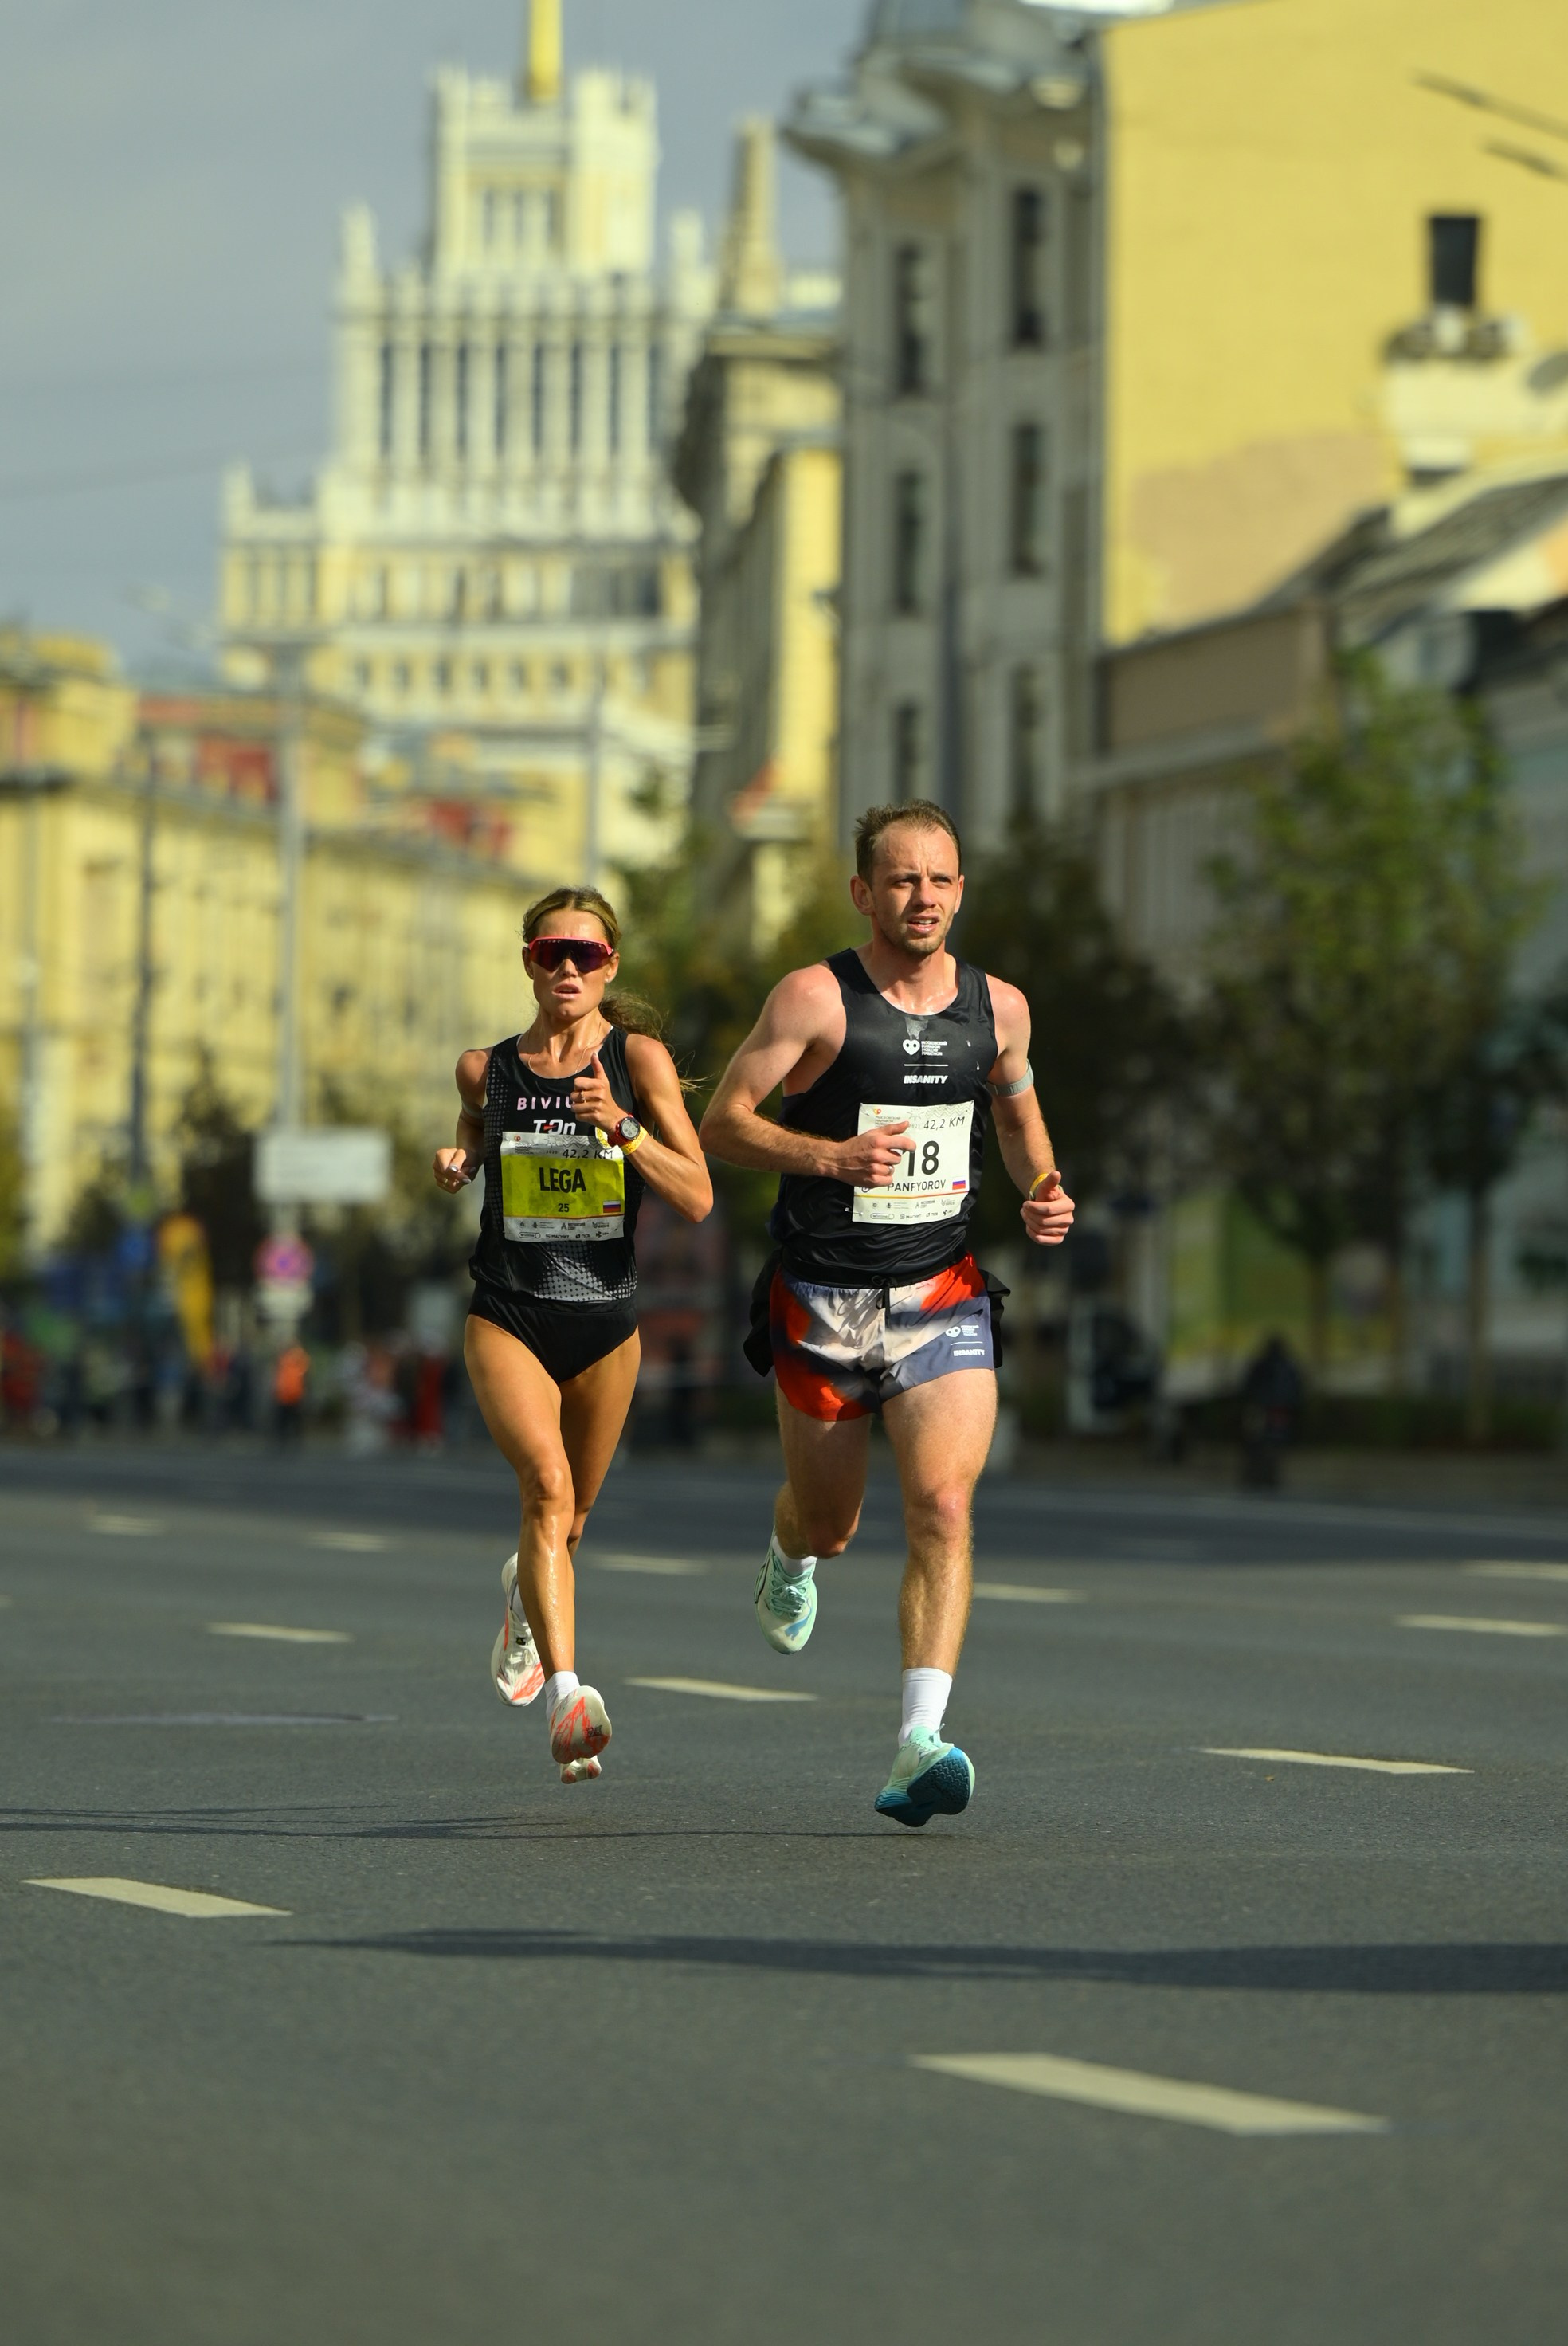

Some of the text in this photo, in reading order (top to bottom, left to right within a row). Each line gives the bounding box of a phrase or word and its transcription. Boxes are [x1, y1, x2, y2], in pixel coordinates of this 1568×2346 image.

[904, 1075, 948, 1084] INSANITY
[923, 1116, 965, 1131] 42,2 KM
[562, 1149, 613, 1159] 42,2 KM
[902, 1140, 939, 1176] 18
[539, 1167, 586, 1193] LEGA
[887, 1179, 947, 1191] PANFYOROV
[558, 1203, 570, 1212] 25
